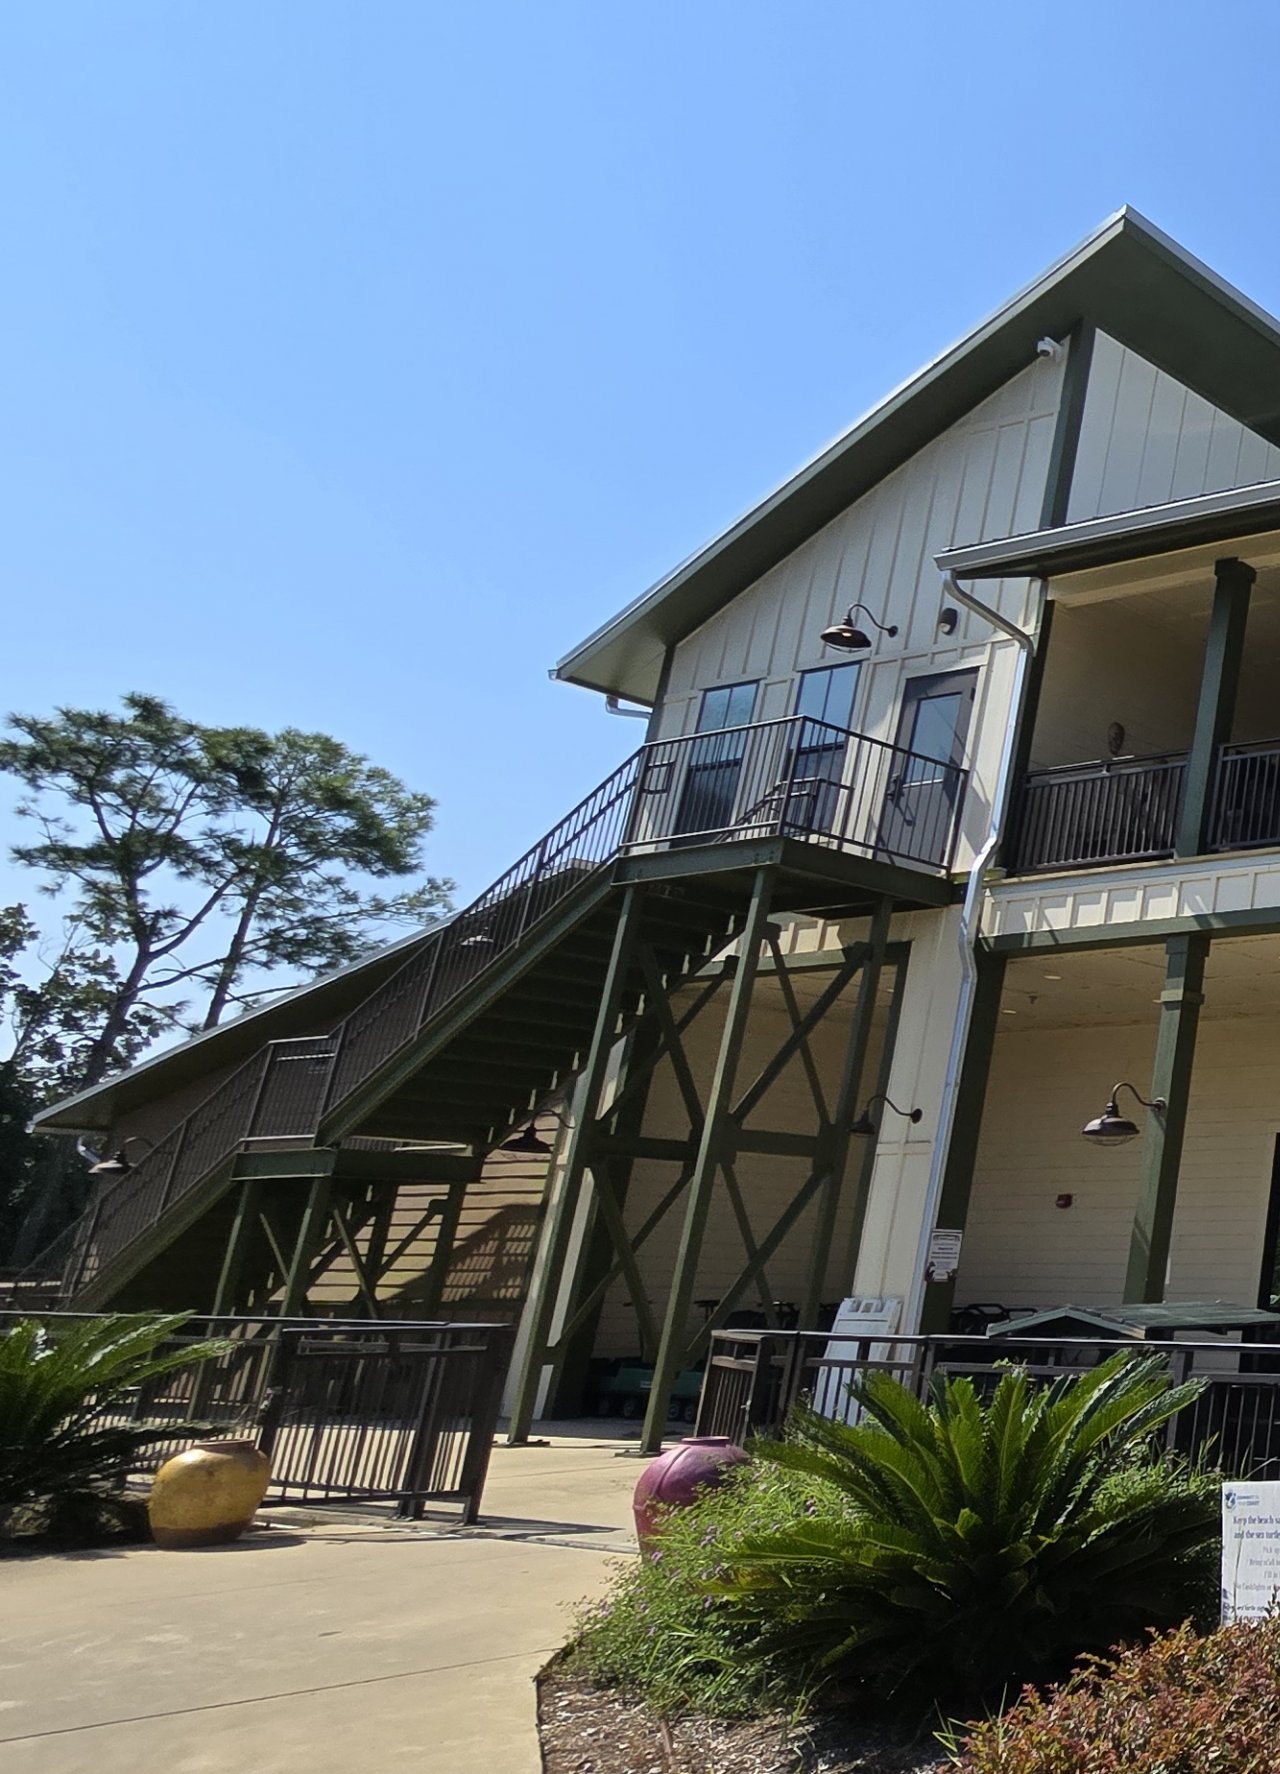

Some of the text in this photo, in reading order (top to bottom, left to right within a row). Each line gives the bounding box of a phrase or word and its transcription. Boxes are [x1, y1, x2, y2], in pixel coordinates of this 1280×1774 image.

[1248, 1515, 1256, 1524] the
[1257, 1515, 1274, 1524] beach
[1245, 1530, 1255, 1539] the
[1255, 1531, 1264, 1539] sea
